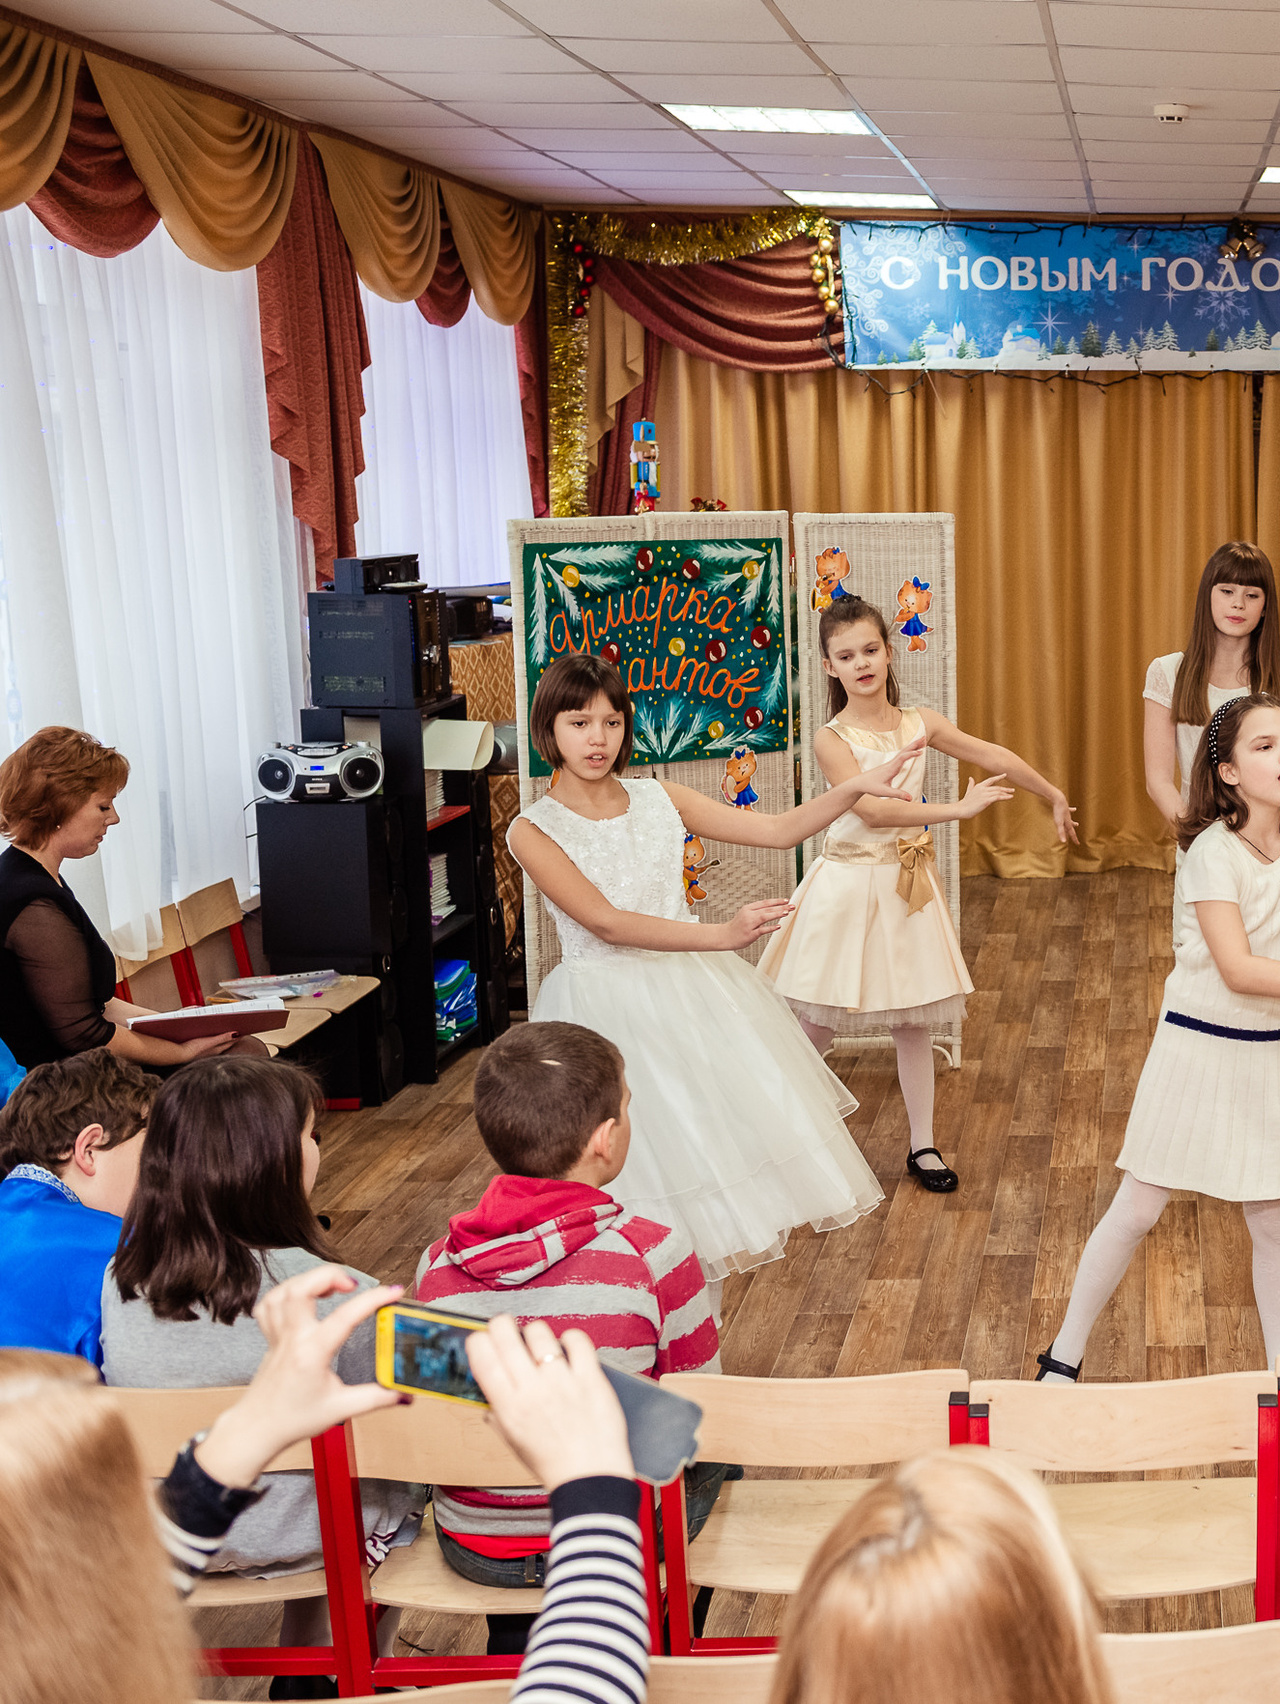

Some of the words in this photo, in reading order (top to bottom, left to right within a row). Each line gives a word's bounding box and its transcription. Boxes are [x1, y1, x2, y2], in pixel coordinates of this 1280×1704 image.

[880, 255, 916, 290] С
[938, 255, 1118, 292] НОВЫМ
[617, 655, 761, 708] антов
